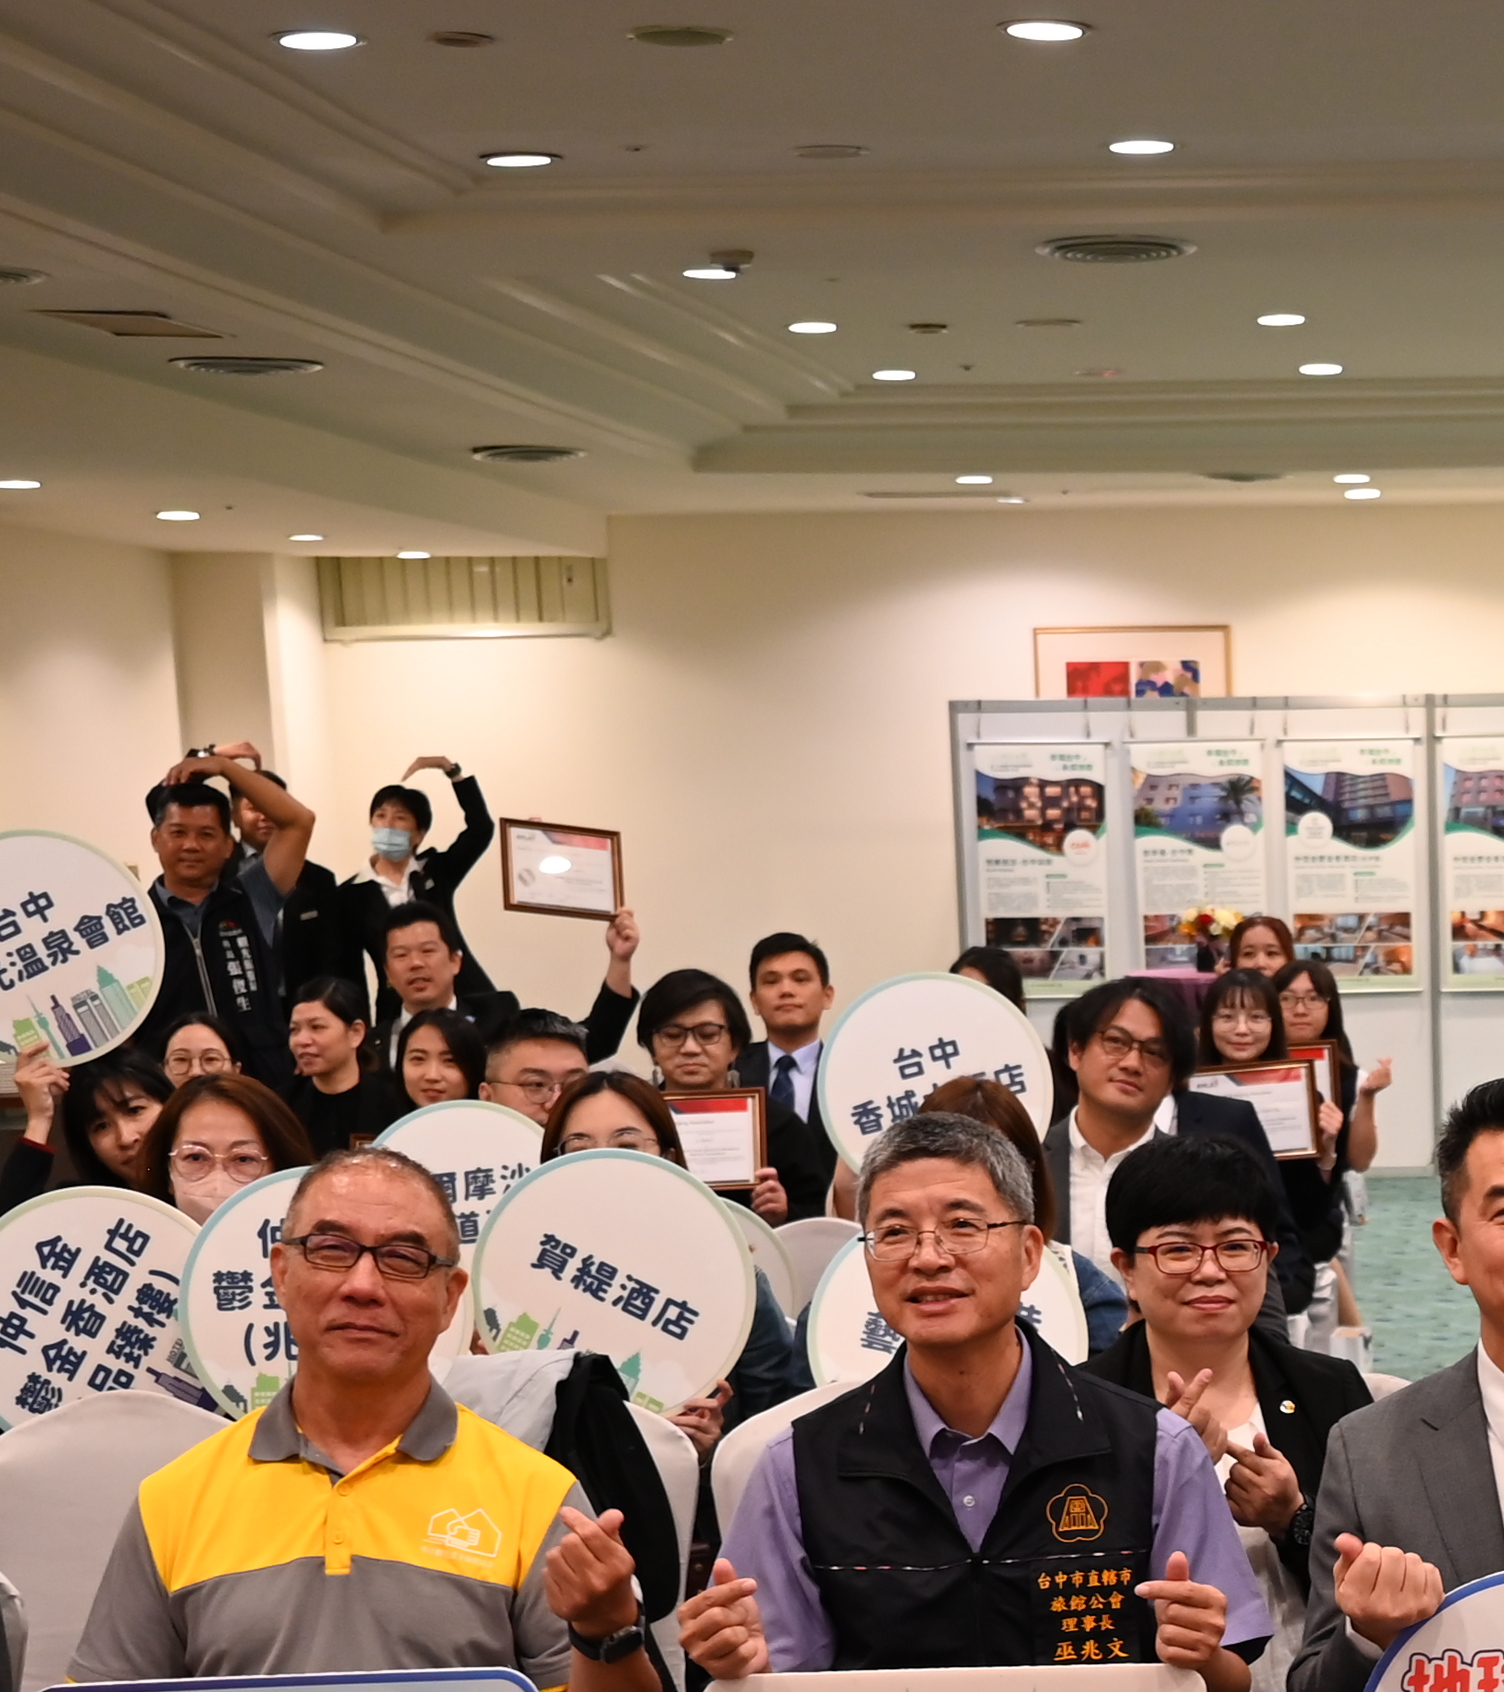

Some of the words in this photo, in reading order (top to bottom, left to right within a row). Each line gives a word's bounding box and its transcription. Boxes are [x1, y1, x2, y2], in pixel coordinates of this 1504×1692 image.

[893, 1037, 960, 1080] 台中
[850, 1063, 1027, 1135] 香城店
[530, 1233, 700, 1341] 賀緹酒店
[1049, 1591, 1126, 1612] 旅館公會
[1060, 1614, 1116, 1632] 理事長
[1052, 1637, 1130, 1662] 巫兆文
